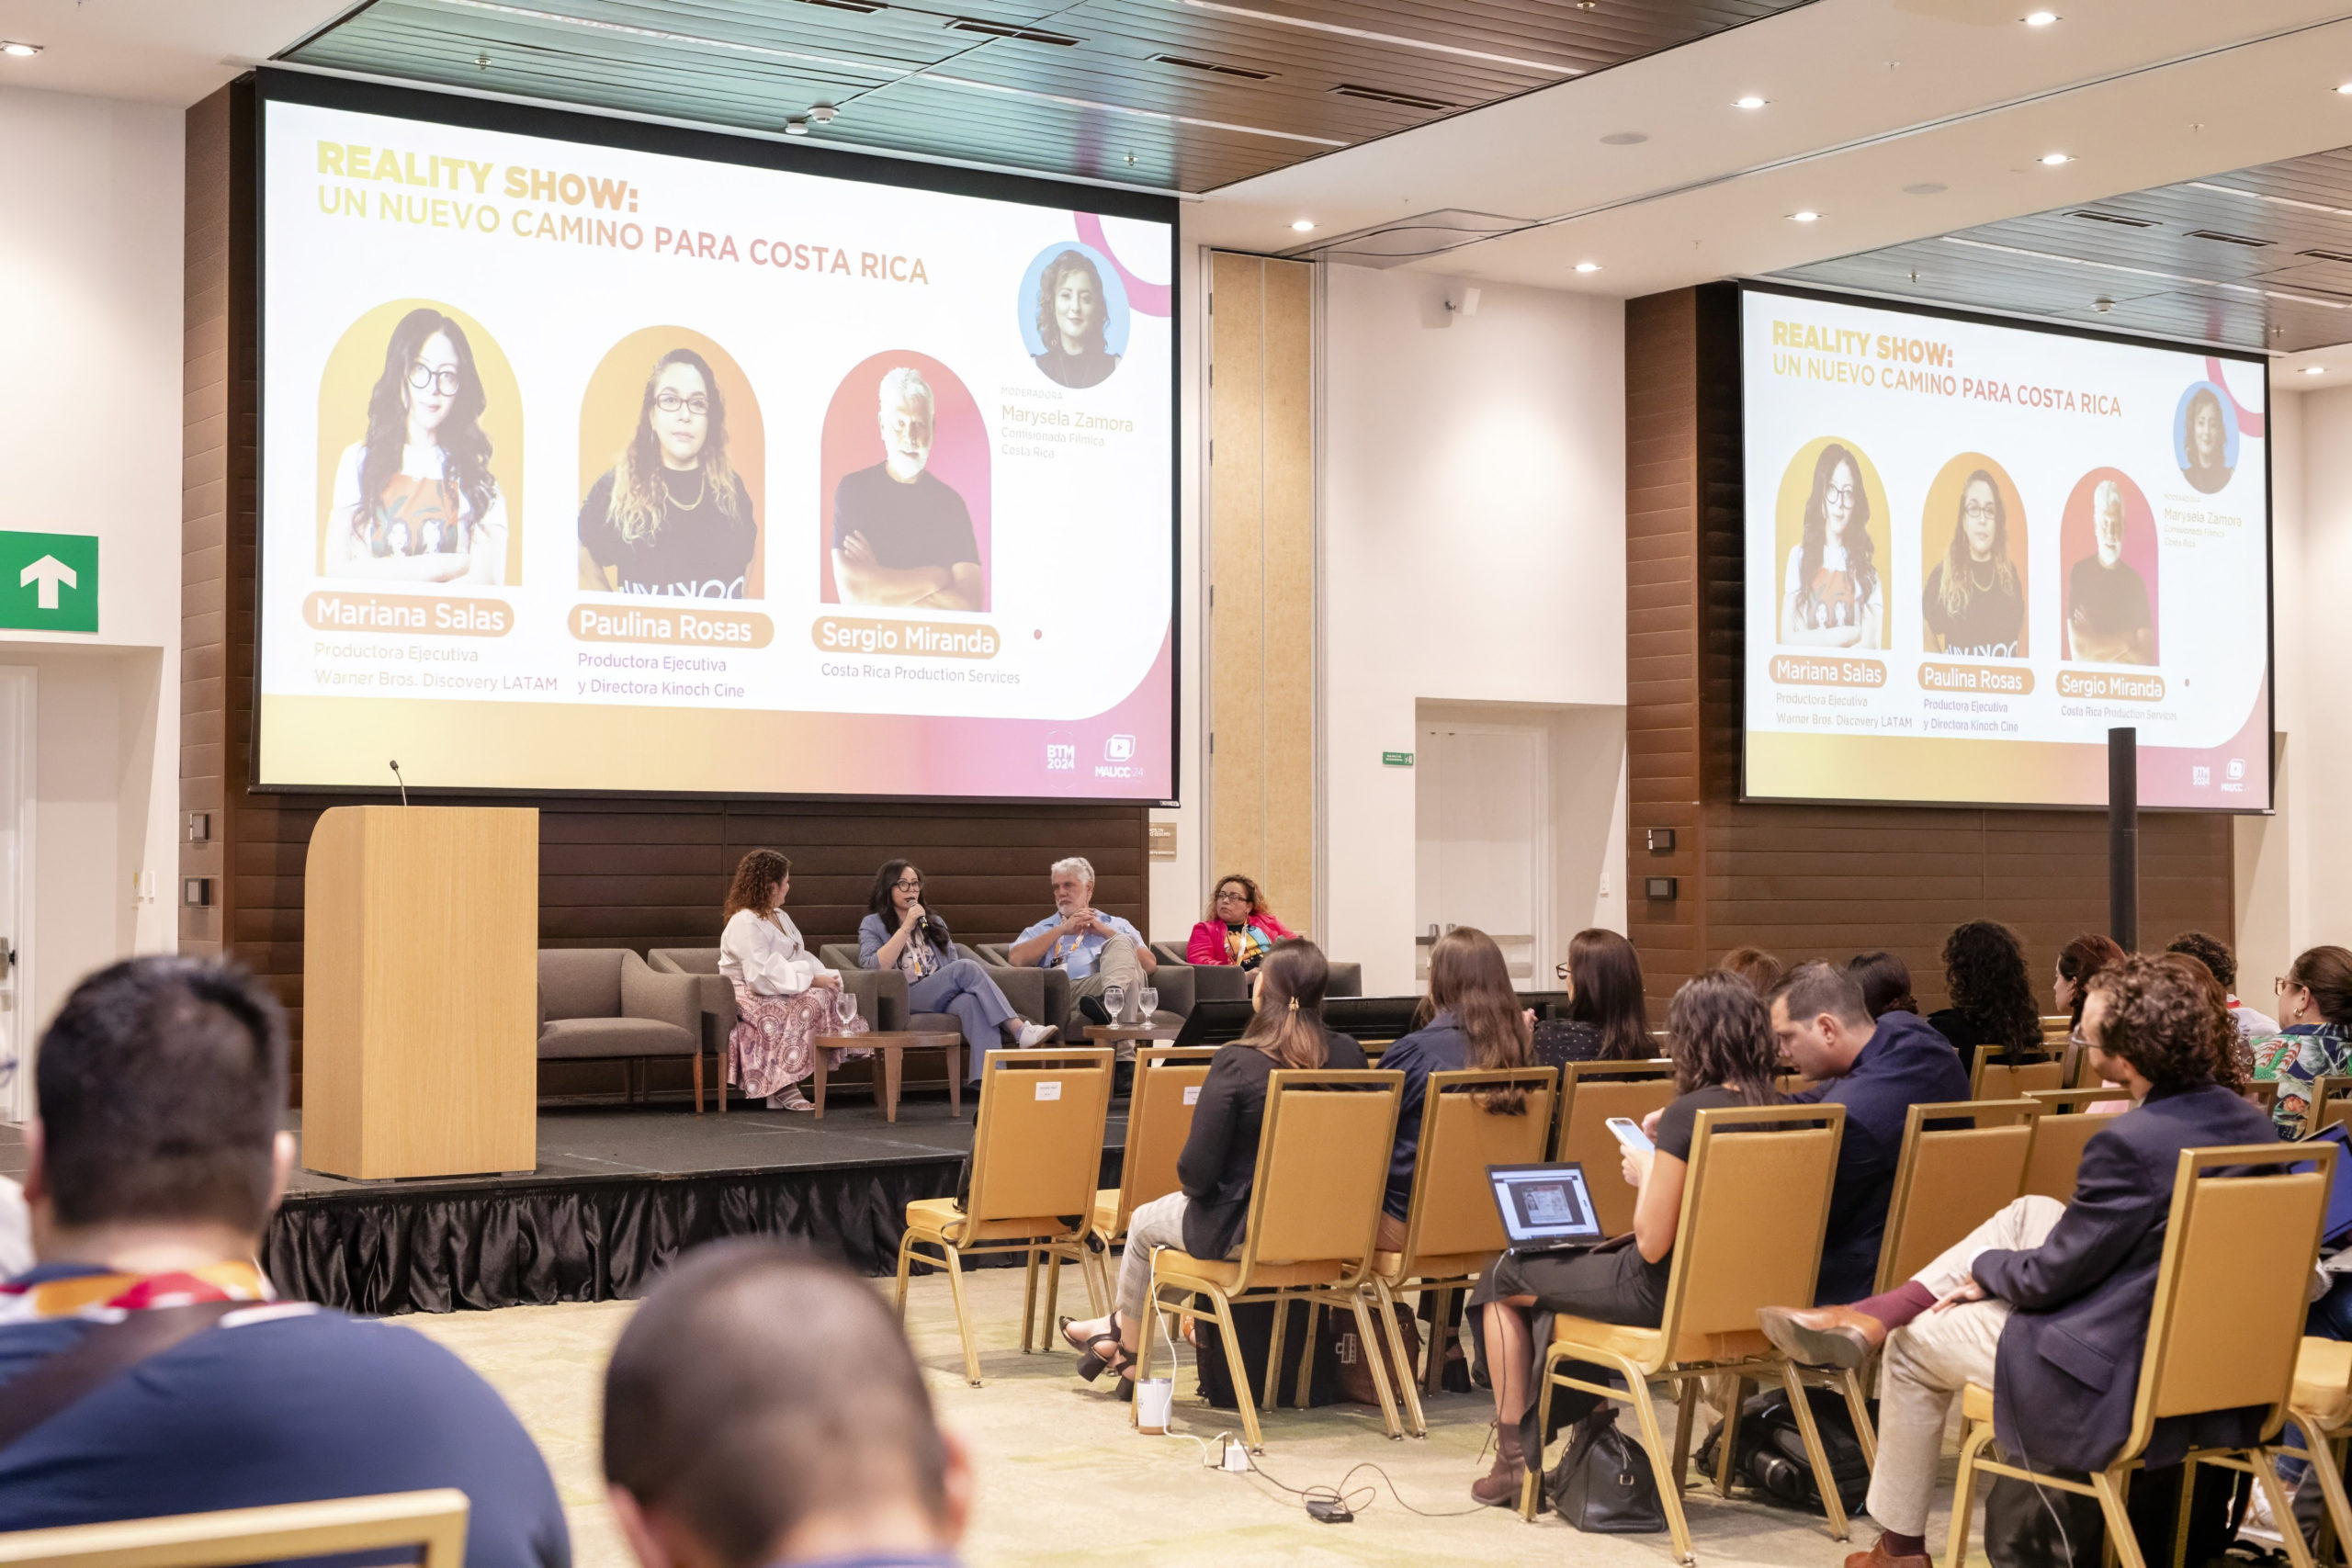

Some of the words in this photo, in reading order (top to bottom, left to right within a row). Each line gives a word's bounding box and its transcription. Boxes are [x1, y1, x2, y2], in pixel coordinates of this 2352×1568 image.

[317, 140, 494, 194] REALITY
[503, 165, 639, 213] SHOW:
[318, 186, 367, 218] UN
[379, 192, 501, 233] NUEVO
[512, 209, 644, 250] CAMINO
[655, 226, 740, 263] PARA
[750, 239, 851, 276] COSTA
[861, 252, 929, 285] RICA
[1772, 320, 1871, 356] REALITY
[1877, 335, 1953, 368] SHOW:
[1001, 387, 1063, 400] MODERADORA
[1773, 352, 1801, 377] UN
[1807, 357, 1875, 386] NUEVO
[1882, 367, 1957, 396] CAMINO
[1962, 378, 2012, 403] PARA
[2017, 385, 2075, 412] COSTA
[2081, 392, 2122, 417] RICA
[1001, 405, 1070, 426] Marysela
[1074, 412, 1134, 433] Zamora
[1001, 427, 1067, 443] Comisionada
[1001, 444, 1032, 457] Costa
[1033, 446, 1056, 458] Rica
[316, 598, 427, 627] Mariana
[435, 603, 505, 631] Salas
[580, 609, 673, 639] Paulina
[679, 614, 753, 643] Rosas
[822, 622, 899, 652] Sergio
[905, 626, 995, 654] Miranda
[314, 642, 404, 660] Productora
[408, 646, 479, 663] Ejecutiva
[577, 652, 660, 670] Productora
[662, 656, 727, 672] Ejecutiva
[314, 669, 374, 685] Warner
[379, 671, 418, 687] Bros.
[423, 672, 499, 693] Discovery
[503, 675, 559, 692] LATAM
[820, 662, 860, 677] Costa
[862, 664, 891, 679] Rica
[894, 665, 966, 682] Production
[967, 669, 1022, 684] Services
[1777, 660, 1838, 682] Mariana
[1842, 662, 1883, 683] Salas
[1925, 667, 1976, 688] Paulina
[1981, 671, 2022, 690] Rosas
[577, 680, 587, 695] y
[590, 679, 659, 695] Directora
[662, 682, 710, 697] Kinoch
[714, 683, 746, 698] Cine
[2062, 675, 2106, 696] Sergio
[2109, 678, 2162, 696] Miranda
[1776, 693, 1826, 705] Productora
[1828, 694, 1868, 707] Ejecutiva
[1924, 699, 1969, 711] Productora
[1971, 702, 2008, 713] Ejecutiva
[1837, 715, 1879, 728] Discovery
[1881, 716, 1913, 728] LATAM
[2061, 705, 2084, 717] Costa
[2085, 705, 2103, 717] Rica
[1046, 744, 1076, 760] BTM
[1046, 758, 1076, 770] 2024
